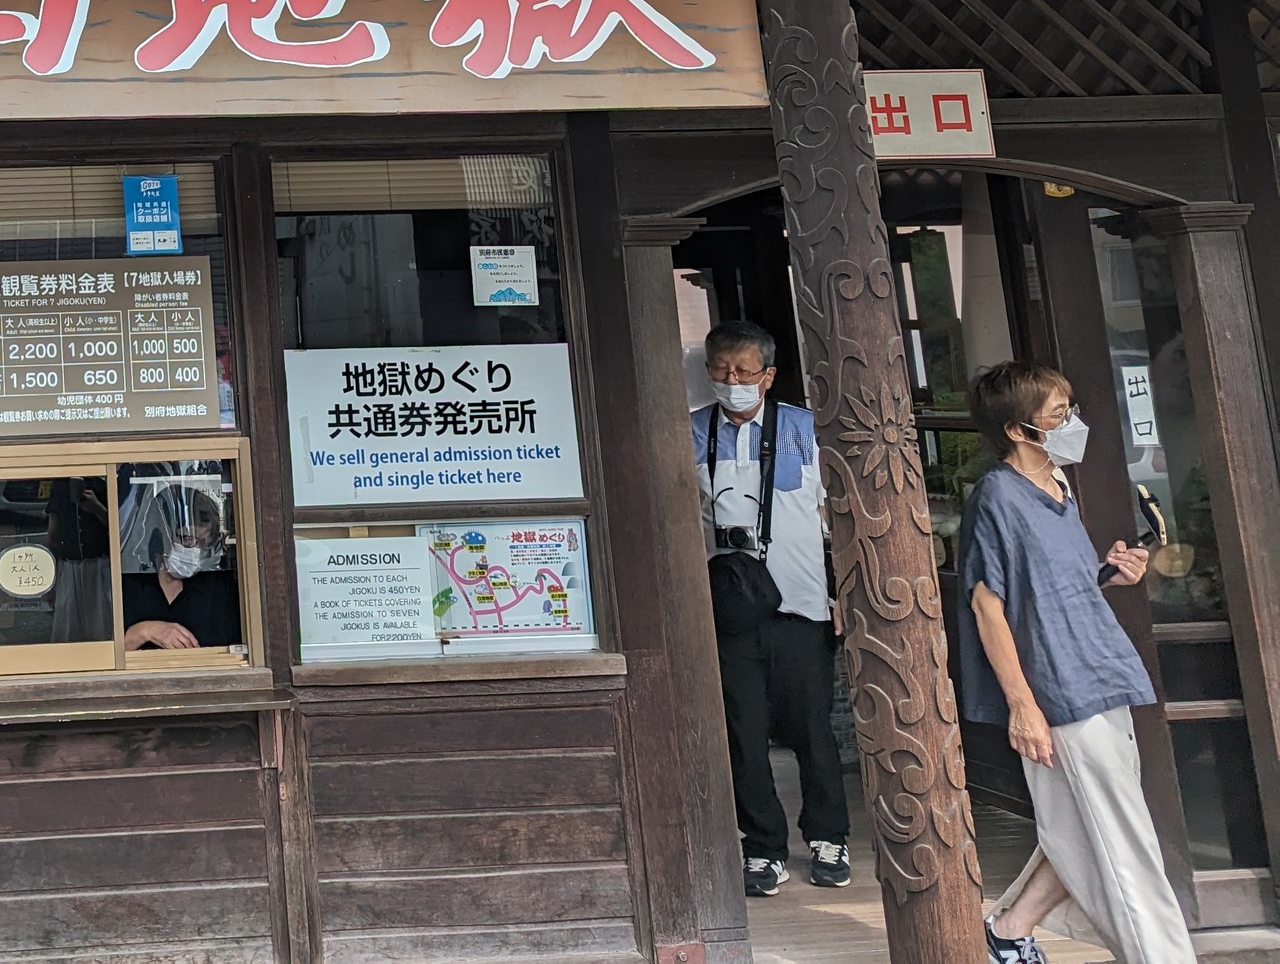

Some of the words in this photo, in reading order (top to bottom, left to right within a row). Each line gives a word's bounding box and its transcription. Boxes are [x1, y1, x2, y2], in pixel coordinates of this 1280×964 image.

[869, 93, 973, 135] 出口
[3, 298, 29, 307] TICKET
[32, 298, 48, 306] FOR
[49, 298, 54, 306] 7
[56, 296, 106, 306] JIGOKU(YEN)
[135, 312, 158, 323] 大人
[171, 311, 195, 322] 小人
[9, 342, 57, 361] 2,200
[68, 340, 117, 358] 1,000
[133, 339, 165, 356] 1,000
[173, 338, 198, 354] 500
[10, 371, 58, 390] 1,500
[83, 369, 118, 386] 650
[140, 368, 165, 383] 800
[175, 367, 200, 382] 400
[341, 360, 513, 398] 地獄めぐり
[144, 404, 207, 418] 別府地獄組合
[1128, 375, 1153, 436] 出口
[327, 398, 537, 439] 共通券発売所
[310, 450, 335, 466] We
[339, 448, 365, 465] sell
[369, 447, 429, 467] general
[433, 445, 513, 462] admission
[516, 443, 561, 460] ticket
[353, 471, 383, 488] and
[387, 469, 435, 489] single
[437, 468, 483, 485] ticket
[486, 467, 522, 483] here
[327, 553, 401, 566] ADMISSION
[312, 577, 328, 585] THE
[330, 575, 371, 585] ADMISSION
[373, 575, 385, 583] TO
[386, 574, 408, 583] EACH
[349, 587, 377, 595] JIGOKU
[313, 601, 319, 609] A
[320, 600, 340, 609] BOOK
[341, 599, 351, 608] OF
[353, 598, 383, 607] TICKETS
[384, 597, 421, 606] COVERING
[314, 612, 329, 620] THE
[332, 611, 373, 620] ADMISSION
[377, 610, 387, 618] TO
[390, 609, 420, 618] SEVEN
[340, 622, 370, 631] JIGOKUS
[373, 622, 380, 630] IS
[383, 621, 418, 629] AVAILABLE
